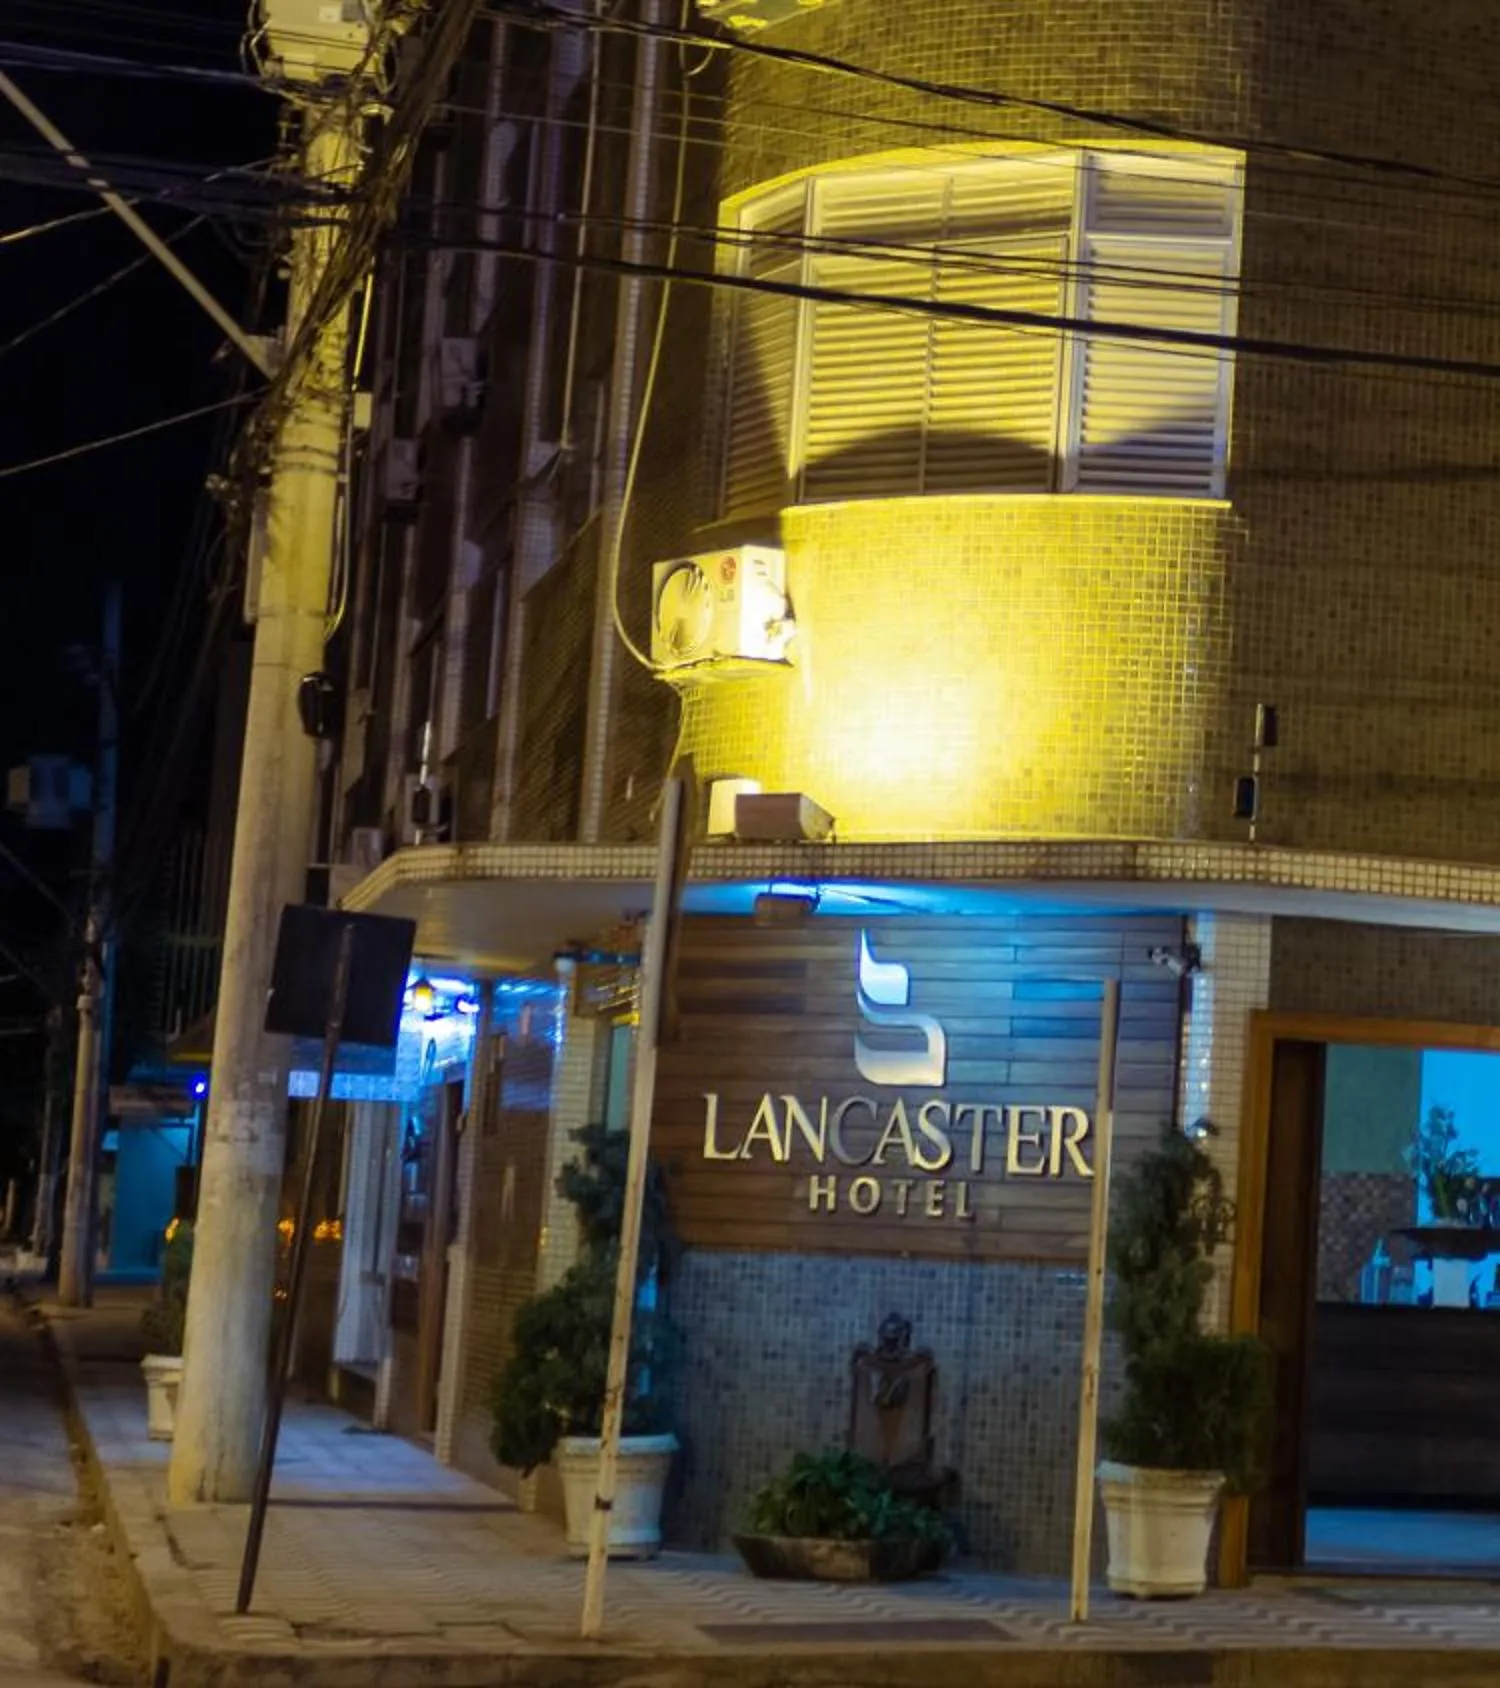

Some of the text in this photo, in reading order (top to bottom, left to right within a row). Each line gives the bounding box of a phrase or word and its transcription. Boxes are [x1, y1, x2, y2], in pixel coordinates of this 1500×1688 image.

[719, 588, 735, 603] LG
[703, 1093, 1094, 1178] LANCASTER
[808, 1176, 975, 1218] HOTEL
